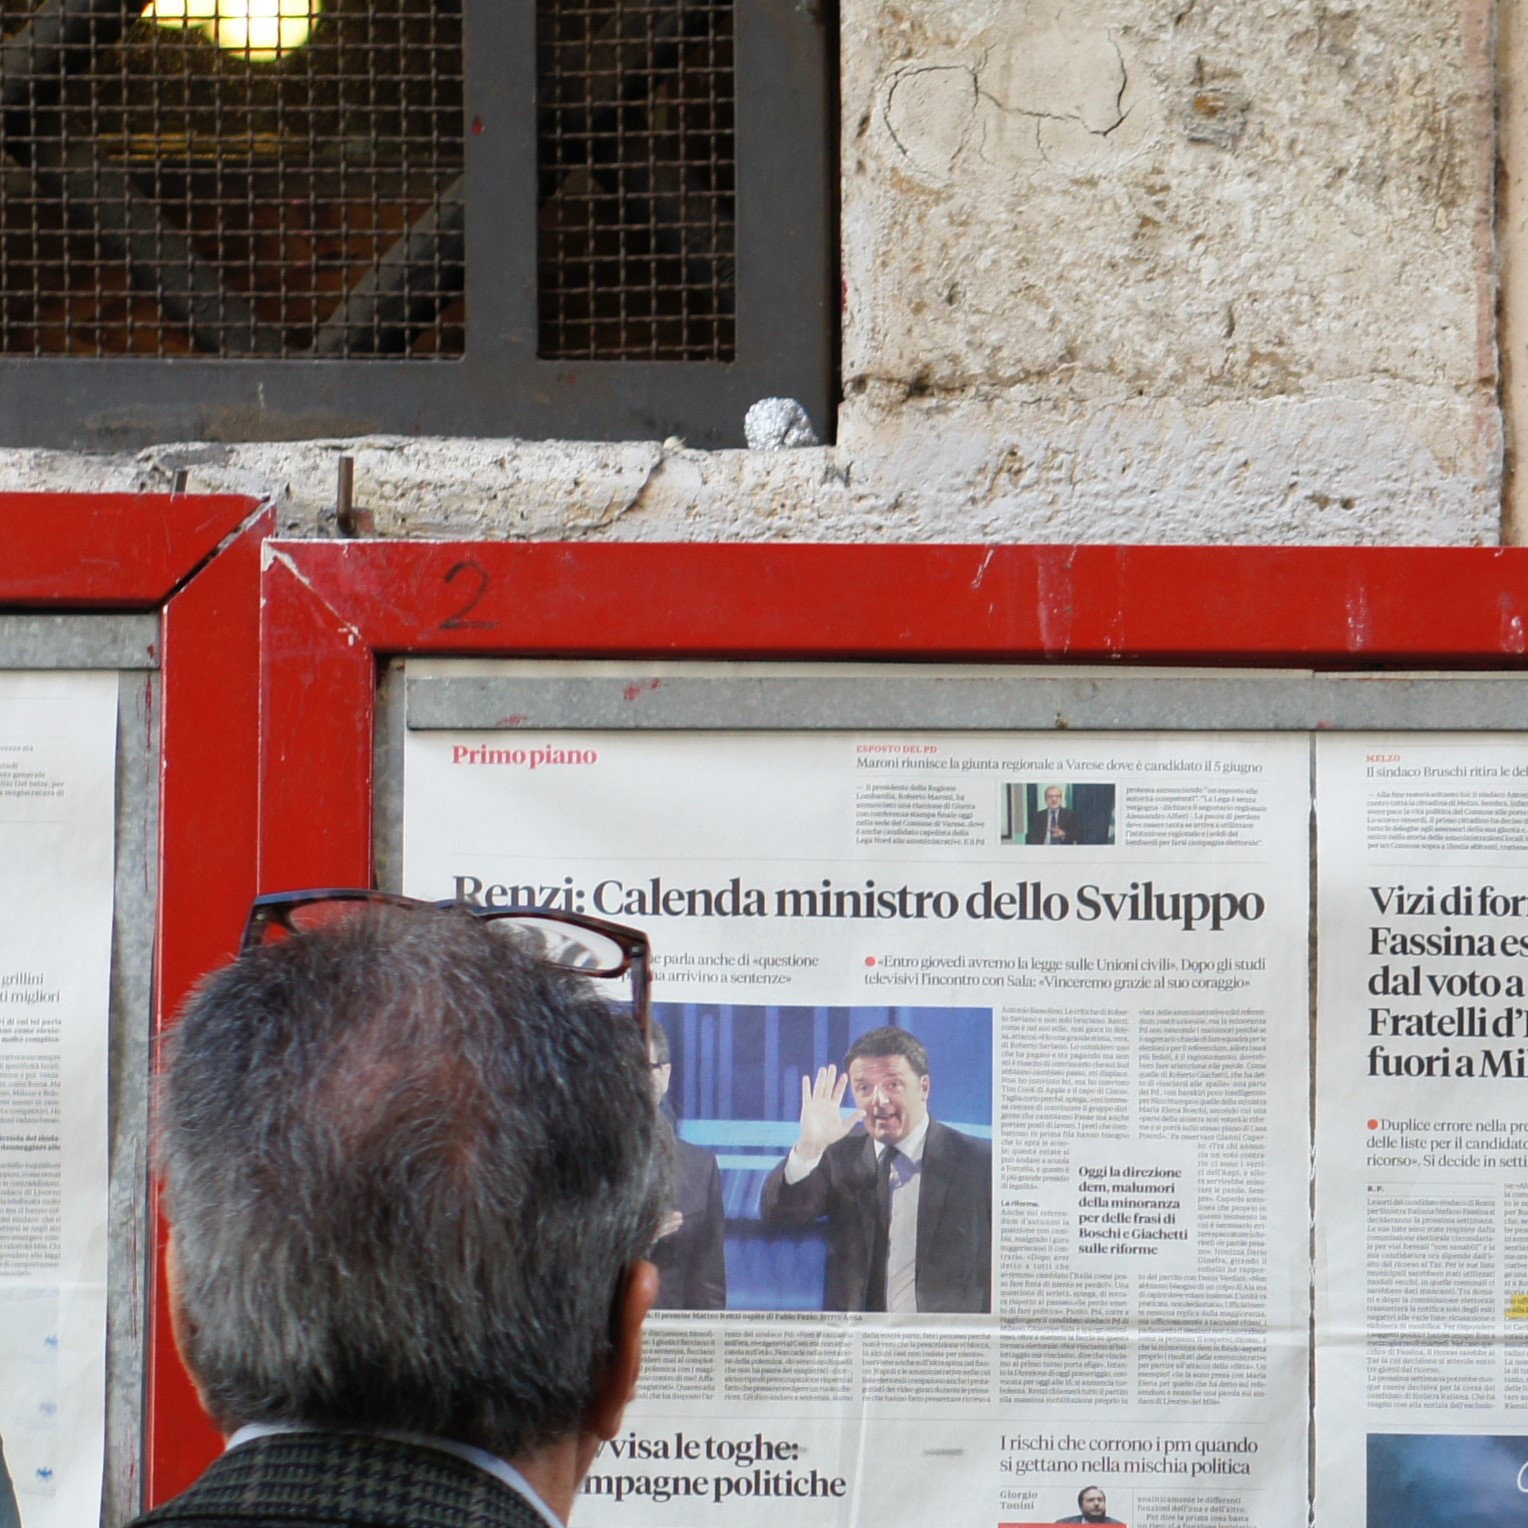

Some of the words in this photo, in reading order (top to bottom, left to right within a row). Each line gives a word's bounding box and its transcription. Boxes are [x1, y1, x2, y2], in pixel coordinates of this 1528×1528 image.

[438, 560, 499, 632] 2
[453, 744, 526, 764] Primo
[530, 744, 597, 769] piano
[857, 757, 899, 768] Maroni
[902, 757, 947, 769] riunisce
[950, 757, 960, 769] la
[962, 758, 999, 771] giunta
[1001, 758, 1054, 772] regionale
[1056, 761, 1063, 770] a
[1066, 759, 1104, 770] Varese
[1106, 759, 1134, 771] dove
[1136, 760, 1143, 771] è
[1144, 760, 1202, 771] candidato
[1205, 760, 1211, 772] il
[1213, 761, 1221, 771] 5
[1222, 761, 1263, 775] giugno
[453, 875, 586, 914] Renzi:
[593, 877, 768, 917] Calenda
[775, 879, 959, 919] ministro
[966, 881, 1069, 921] dello
[1077, 881, 1265, 931] Sviluppo
[1369, 885, 1436, 915] Vizi
[1440, 886, 1473, 916] di
[1369, 926, 1496, 957] Fassina
[663, 952, 695, 967] parla
[698, 953, 735, 966] anche
[737, 953, 750, 966] di
[753, 954, 819, 970] «questione
[2, 972, 43, 988] grillini
[1368, 965, 1421, 996] dal
[1426, 971, 1501, 997] voto
[1505, 976, 1525, 997] a
[11, 989, 60, 1005] migliori
[1369, 1006, 1487, 1037] Fratelli
[1368, 1045, 1451, 1077] fuori
[1455, 1056, 1475, 1077] a
[1078, 1166, 1107, 1179] Oggi
[1110, 1166, 1120, 1177] la
[1122, 1166, 1182, 1178] direzione
[1078, 1181, 1110, 1193] dem,
[1112, 1182, 1175, 1193] malumori
[1078, 1196, 1109, 1208] della
[1111, 1197, 1180, 1209] minoranza
[1079, 1215, 1100, 1225] per
[1101, 1212, 1131, 1223] delle
[1134, 1213, 1161, 1224] frasi
[1163, 1213, 1175, 1224] di
[1079, 1227, 1121, 1239] Boschi
[1123, 1231, 1130, 1239] e
[1131, 1228, 1188, 1240] Giachetti
[1079, 1243, 1108, 1254] sulle
[1110, 1243, 1158, 1255] riforme
[595, 1432, 671, 1460] visa
[675, 1432, 700, 1459] le
[705, 1433, 798, 1467] toghe:
[1001, 1435, 1005, 1450] I
[1010, 1434, 1054, 1450] rischi
[1058, 1434, 1086, 1451] che
[1089, 1440, 1153, 1452] corrono
[1156, 1436, 1160, 1452] i
[1164, 1440, 1191, 1456] pm
[1195, 1437, 1258, 1456] quando
[1000, 1456, 1012, 1472] si
[1016, 1458, 1078, 1475] gettano
[1082, 1456, 1120, 1472] nella
[1124, 1457, 1188, 1473] mischia
[1192, 1458, 1250, 1477] politica
[580, 1471, 708, 1503] mpagne
[714, 1469, 846, 1503] politiche
[1000, 1490, 1038, 1501] Giorgio
[1000, 1500, 1035, 1510] Tonini
